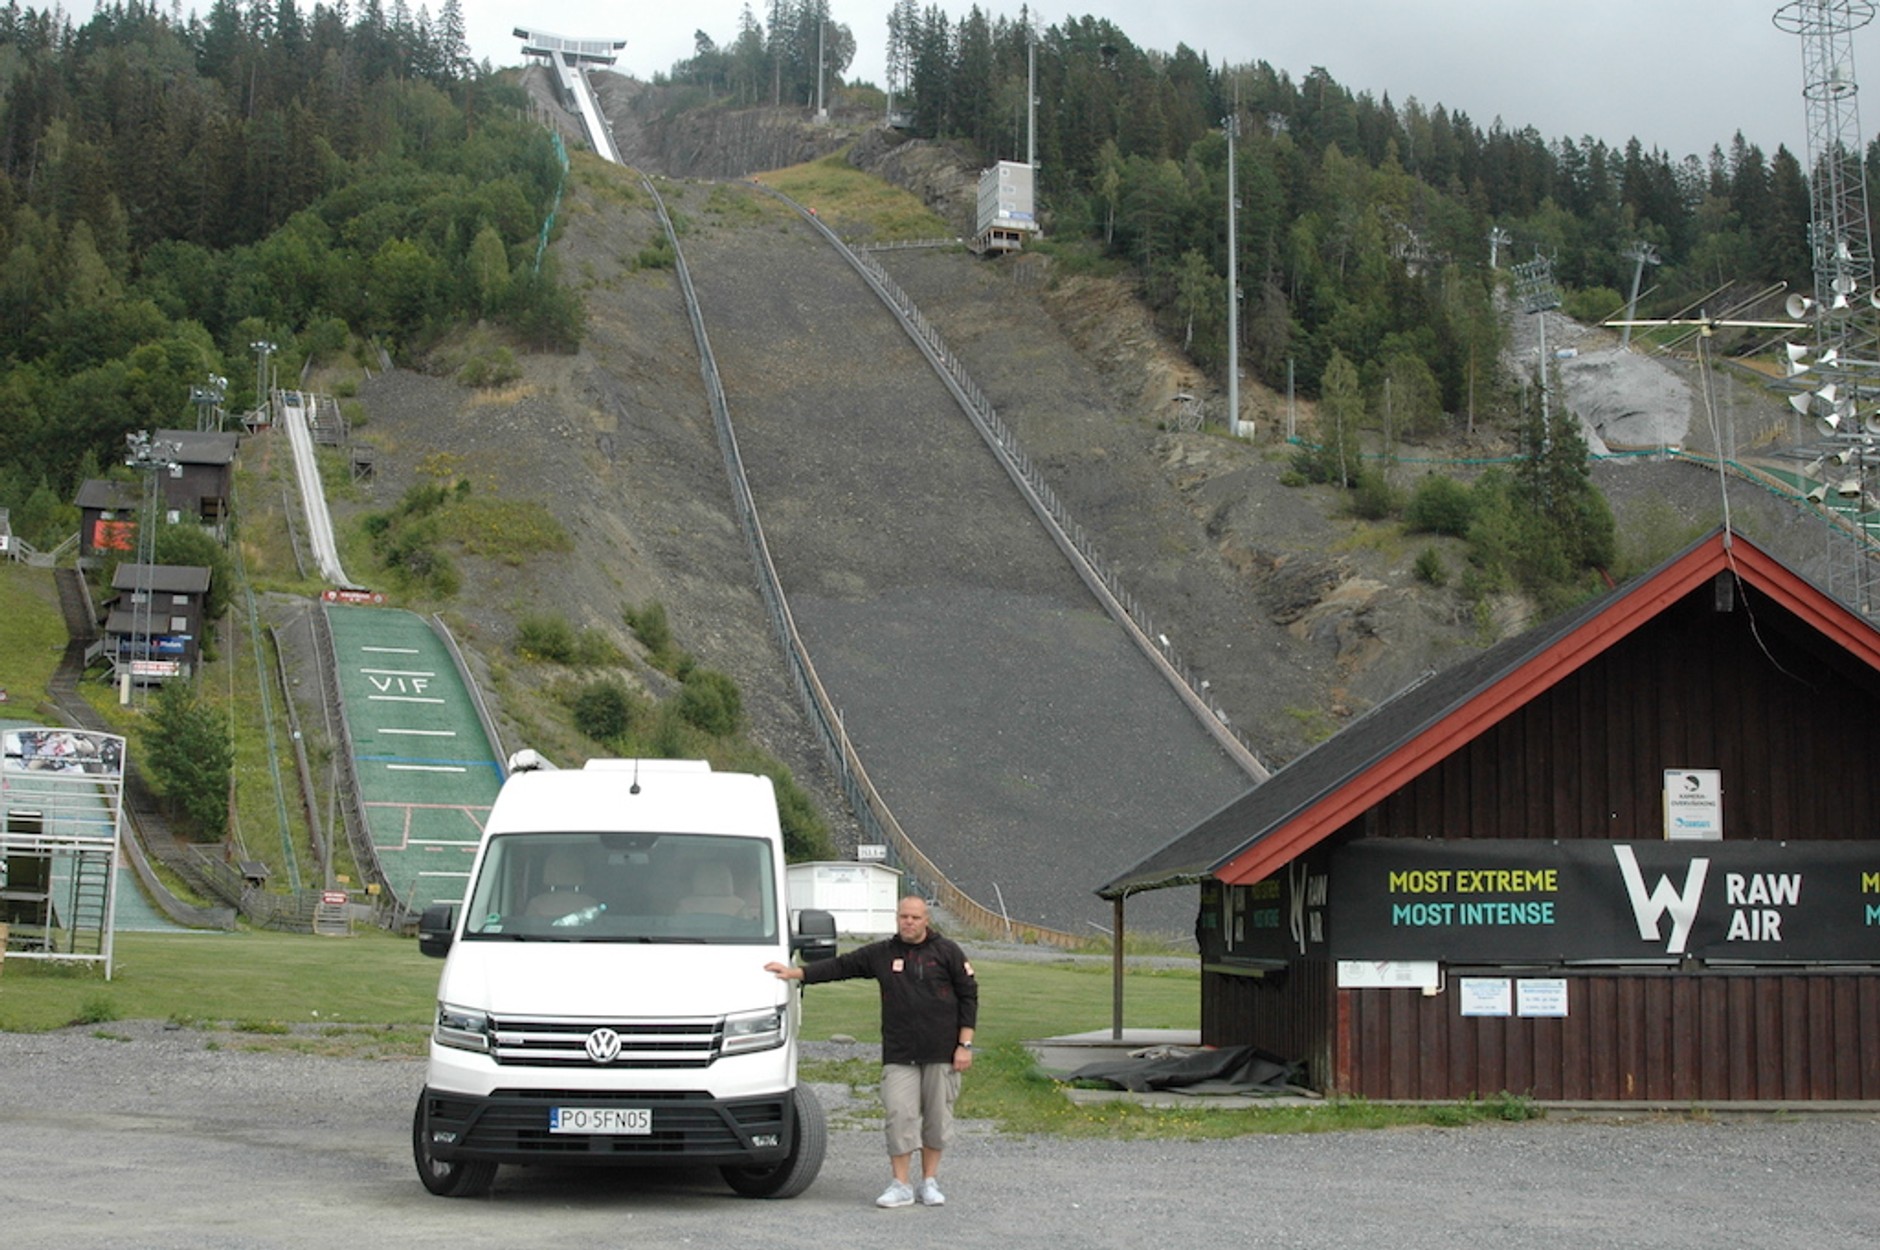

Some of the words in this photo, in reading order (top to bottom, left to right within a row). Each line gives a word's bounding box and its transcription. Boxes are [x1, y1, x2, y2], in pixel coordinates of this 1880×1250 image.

[369, 675, 429, 694] VIF
[1389, 870, 1452, 893] MOST
[1456, 869, 1558, 893] EXTREME
[1725, 873, 1802, 905] RAW
[1392, 903, 1455, 926] MOST
[1459, 902, 1555, 925] INTENSE
[1726, 909, 1782, 941] AIR
